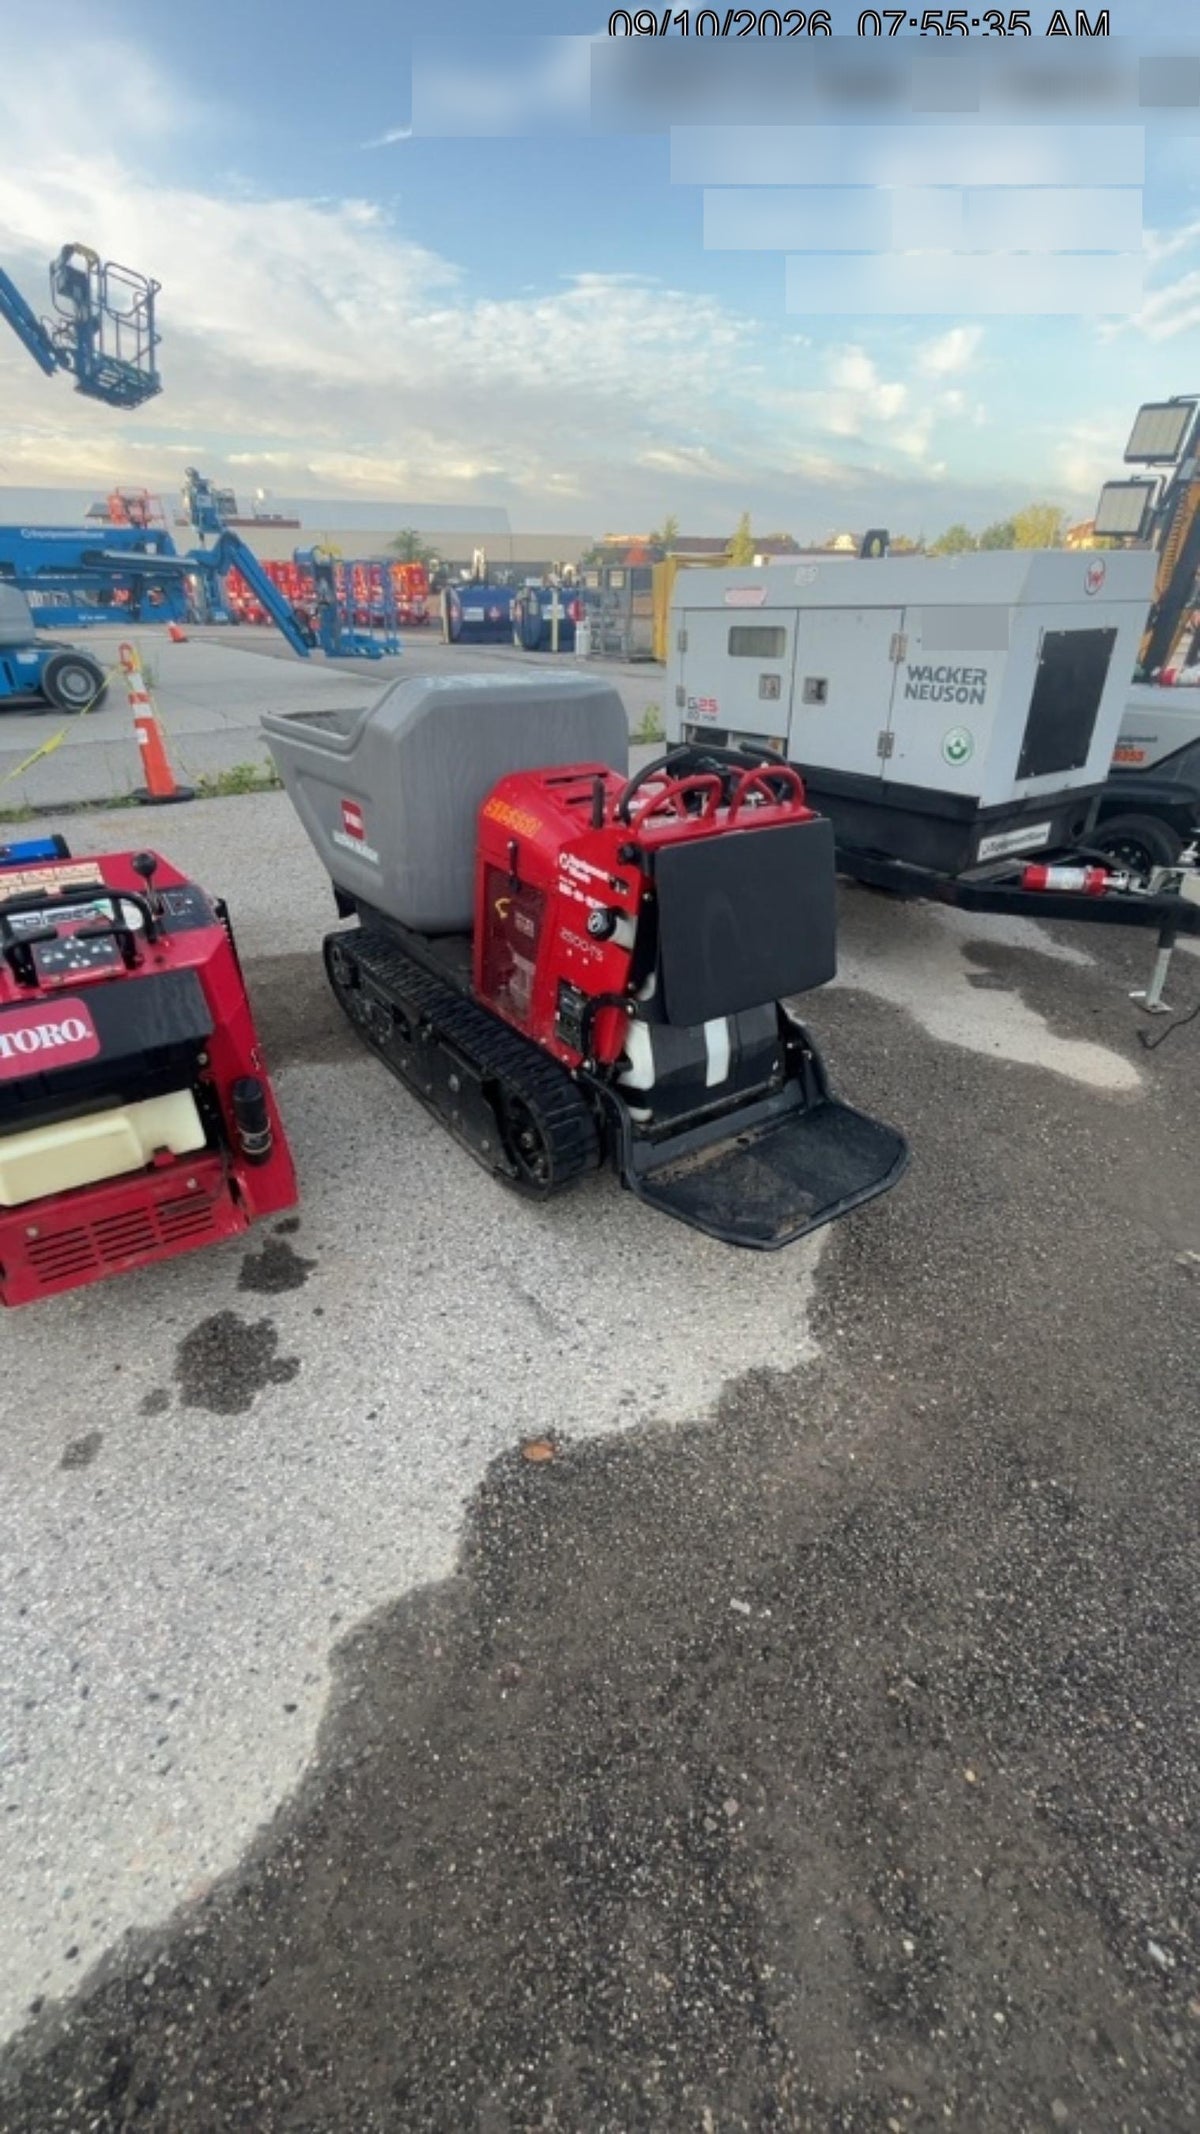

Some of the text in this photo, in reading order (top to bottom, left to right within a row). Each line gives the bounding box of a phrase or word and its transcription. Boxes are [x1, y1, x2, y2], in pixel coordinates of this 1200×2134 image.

[907, 665, 987, 686] WACKER
[905, 682, 986, 705] NEUSON
[0, 1018, 87, 1058] TORO
